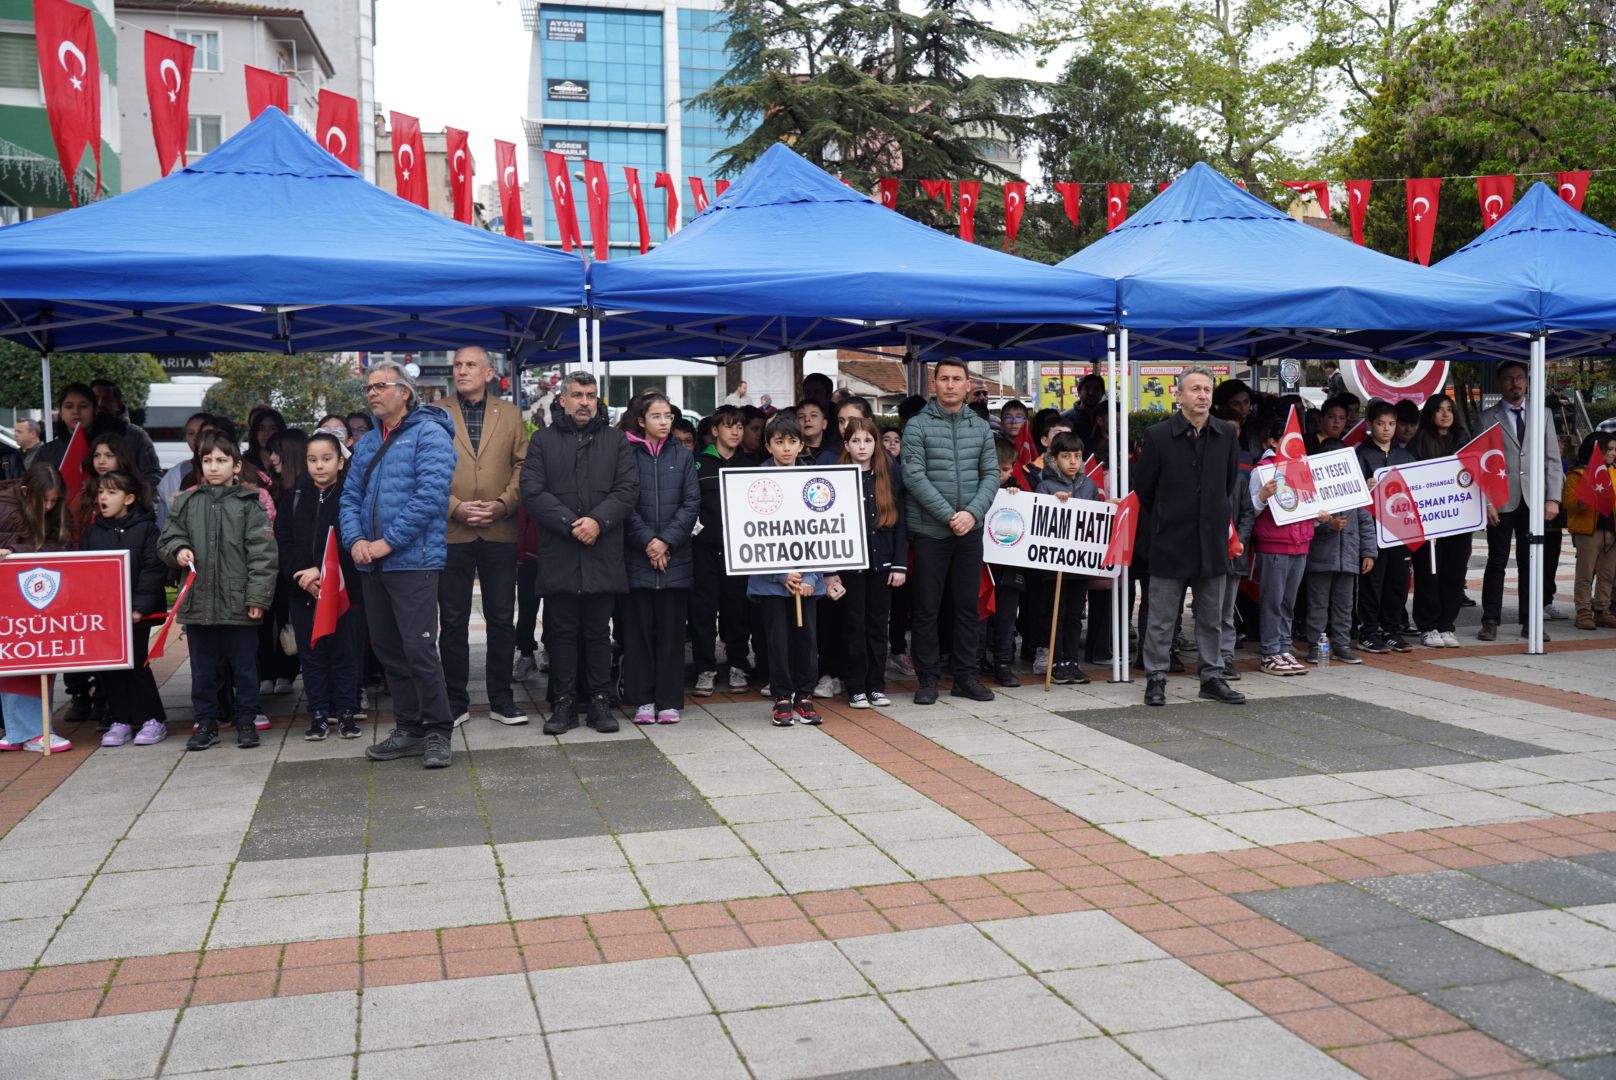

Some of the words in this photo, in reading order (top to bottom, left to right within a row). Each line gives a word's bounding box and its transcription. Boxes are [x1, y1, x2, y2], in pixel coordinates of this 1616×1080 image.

[549, 26, 585, 34] HUKUK
[550, 20, 584, 28] AYGÜN
[1325, 458, 1352, 479] YESEVİ
[1319, 479, 1362, 501] ORTAOKULU
[1407, 482, 1423, 491] URSA
[1447, 491, 1473, 504] PAŞA
[743, 513, 846, 538] ORHANGAZİ
[1030, 496, 1072, 540] İMAM
[739, 539, 854, 563] ORTAOKULU
[0, 612, 106, 638] ÜŞÜNÜR
[0, 636, 85, 660] KOLEJİ
